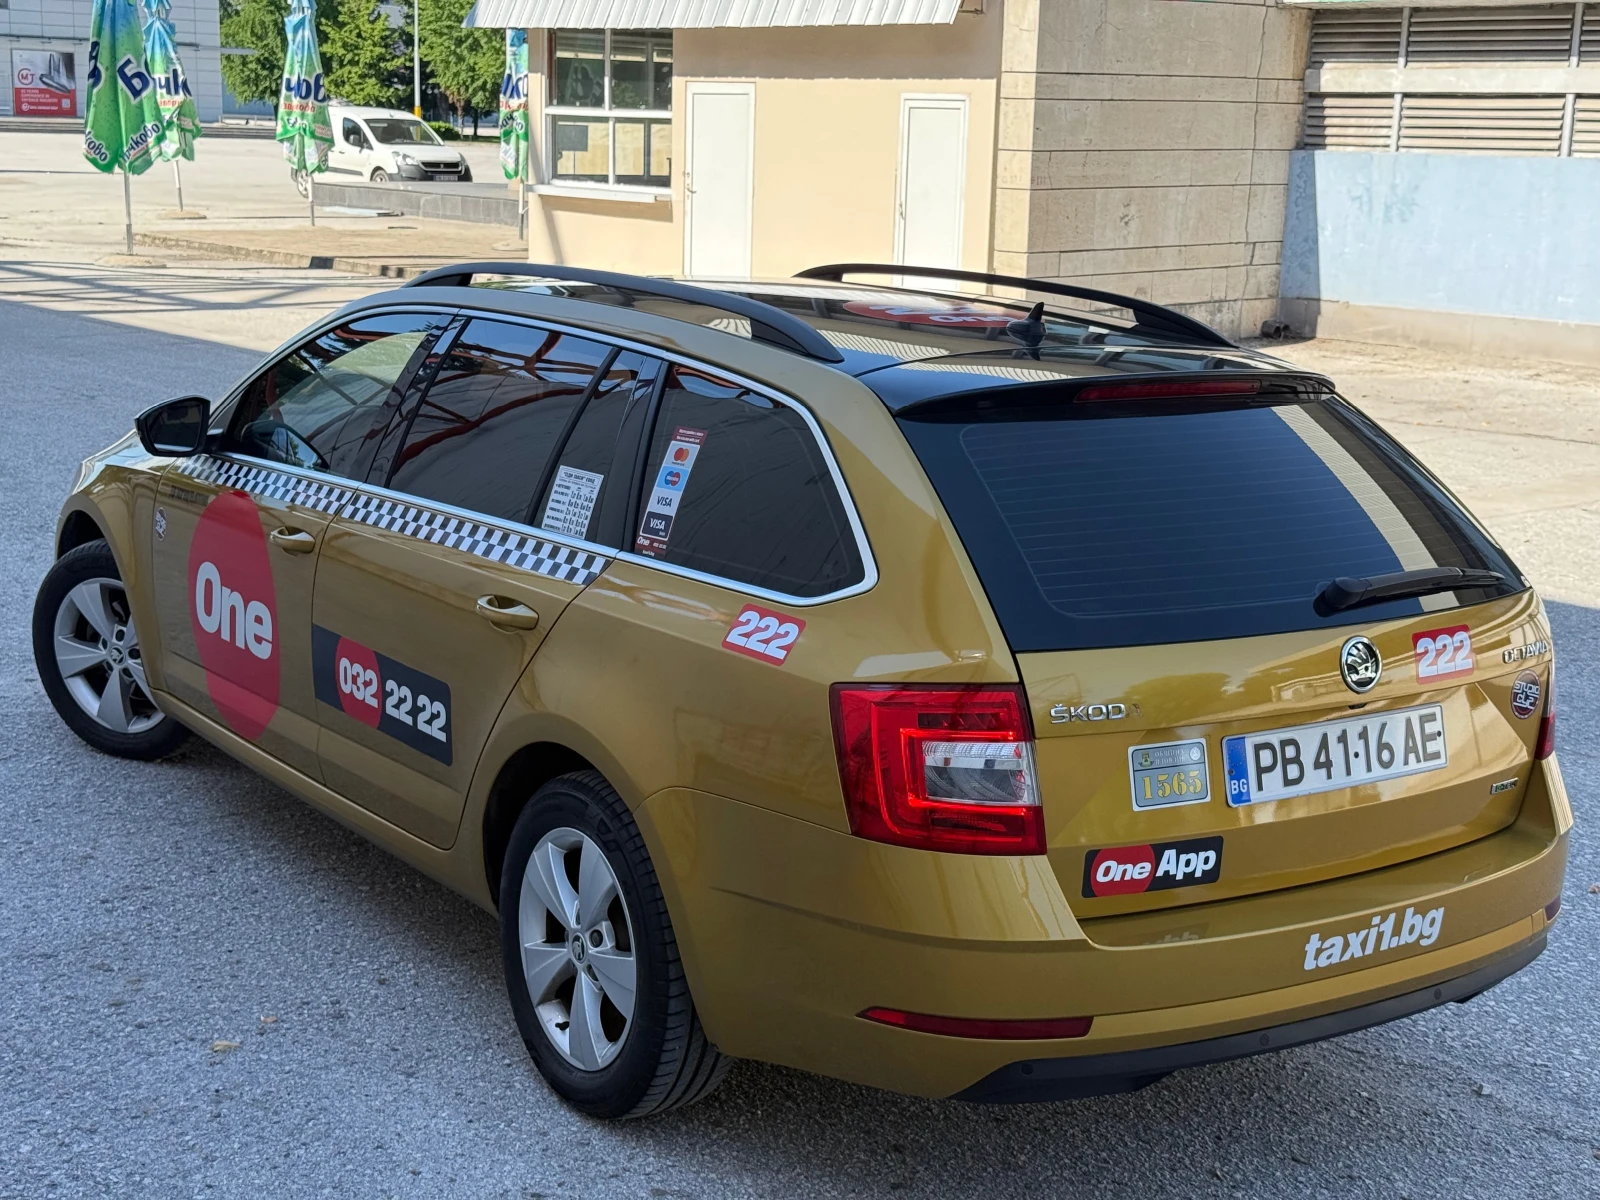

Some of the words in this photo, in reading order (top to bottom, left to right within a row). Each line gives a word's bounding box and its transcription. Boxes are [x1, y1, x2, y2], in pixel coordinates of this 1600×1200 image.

[657, 495, 672, 507] VISA
[637, 536, 650, 546] One
[650, 518, 666, 530] VISA
[195, 561, 272, 660] One
[726, 610, 799, 660] 222
[1417, 631, 1473, 678] 222
[339, 657, 379, 709] 032
[385, 679, 413, 726] 22
[417, 694, 447, 742] 22
[1253, 738, 1305, 792] PB
[1403, 712, 1441, 766] AE
[1142, 769, 1202, 800] 1565
[1230, 779, 1248, 795] BG
[1096, 860, 1152, 883] One
[1155, 849, 1217, 880] App
[1303, 906, 1445, 971] taxi1.bg
